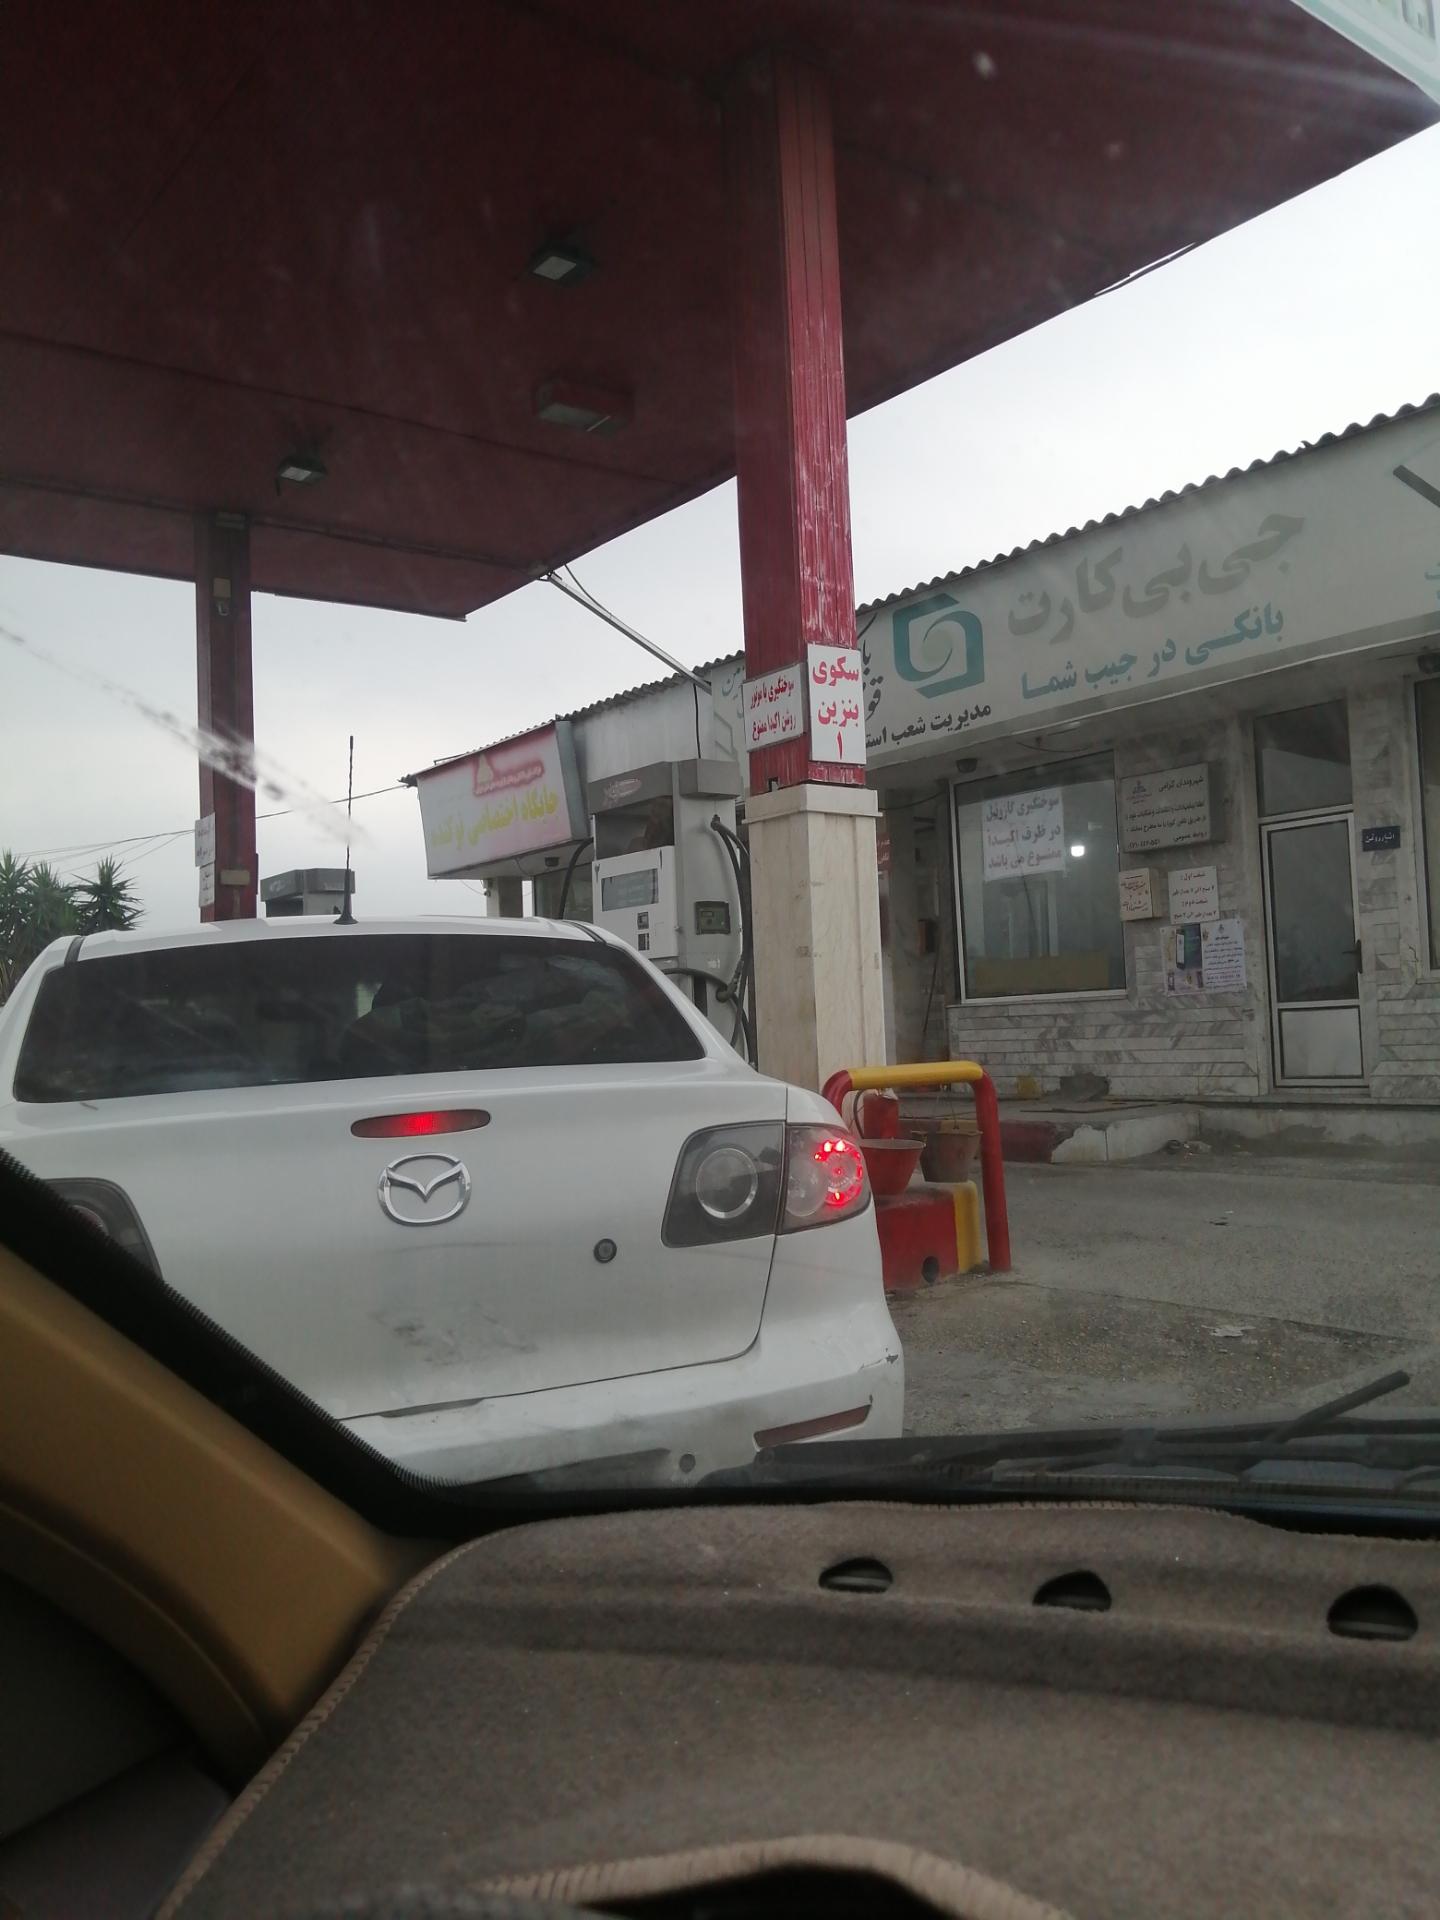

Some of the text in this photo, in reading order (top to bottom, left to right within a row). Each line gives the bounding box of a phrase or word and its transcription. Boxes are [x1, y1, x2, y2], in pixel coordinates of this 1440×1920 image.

[1008, 549, 1123, 645] کارت
[812, 656, 860, 687] سکوی
[1084, 650, 1138, 691] جیب
[1147, 638, 1177, 678] در
[1021, 660, 1078, 700] شما
[817, 700, 860, 728] بنزین
[891, 716, 926, 745] شعب
[930, 703, 992, 732] مدیریت
